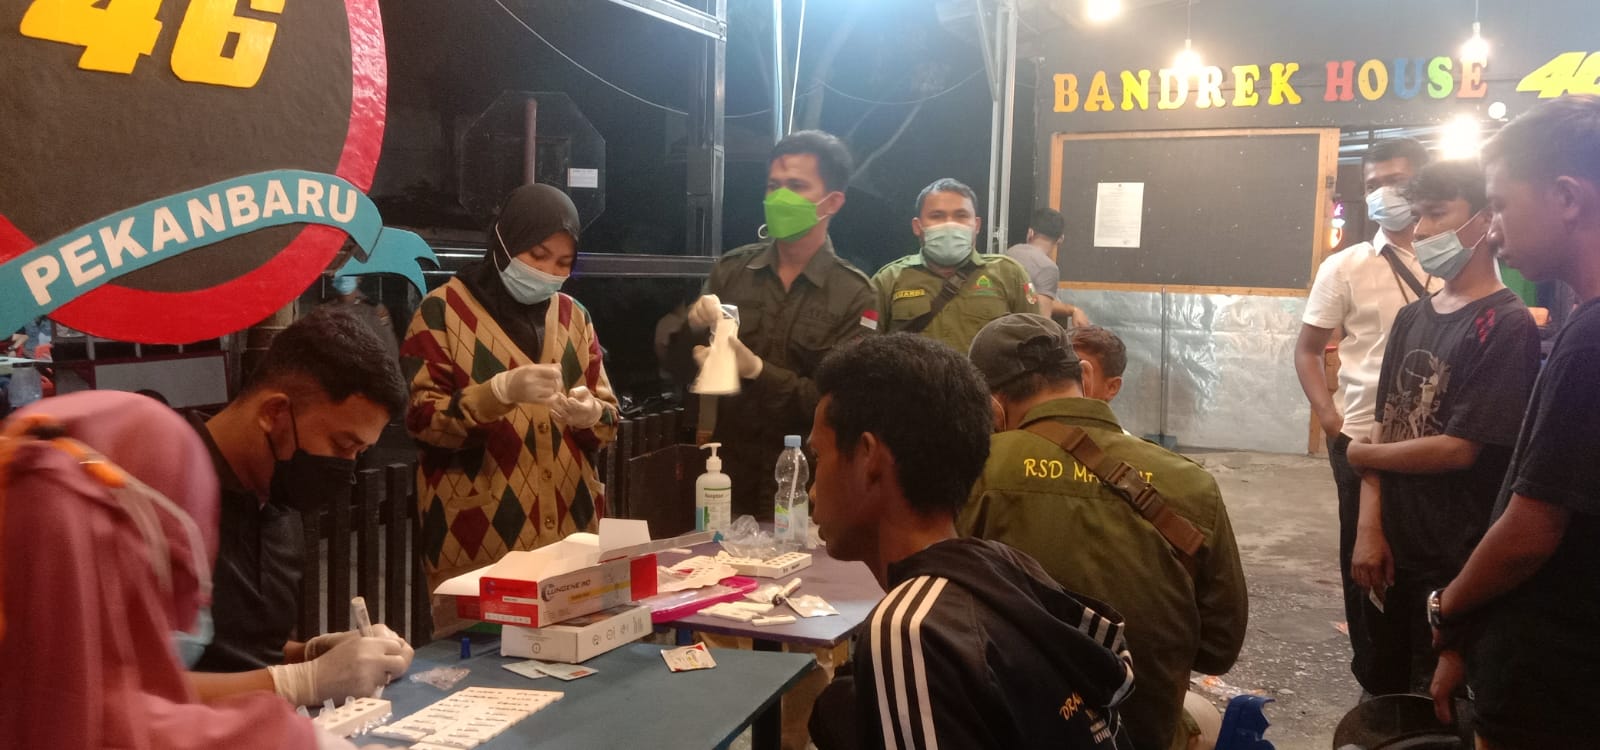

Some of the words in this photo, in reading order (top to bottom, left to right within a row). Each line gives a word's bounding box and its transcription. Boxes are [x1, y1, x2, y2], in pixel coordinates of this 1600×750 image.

[19, 0, 286, 88] 46
[1053, 62, 1302, 112] BANDREK
[1324, 56, 1489, 102] HOUSE
[21, 178, 357, 306] PEKANBARU
[1023, 458, 1064, 479] RSD
